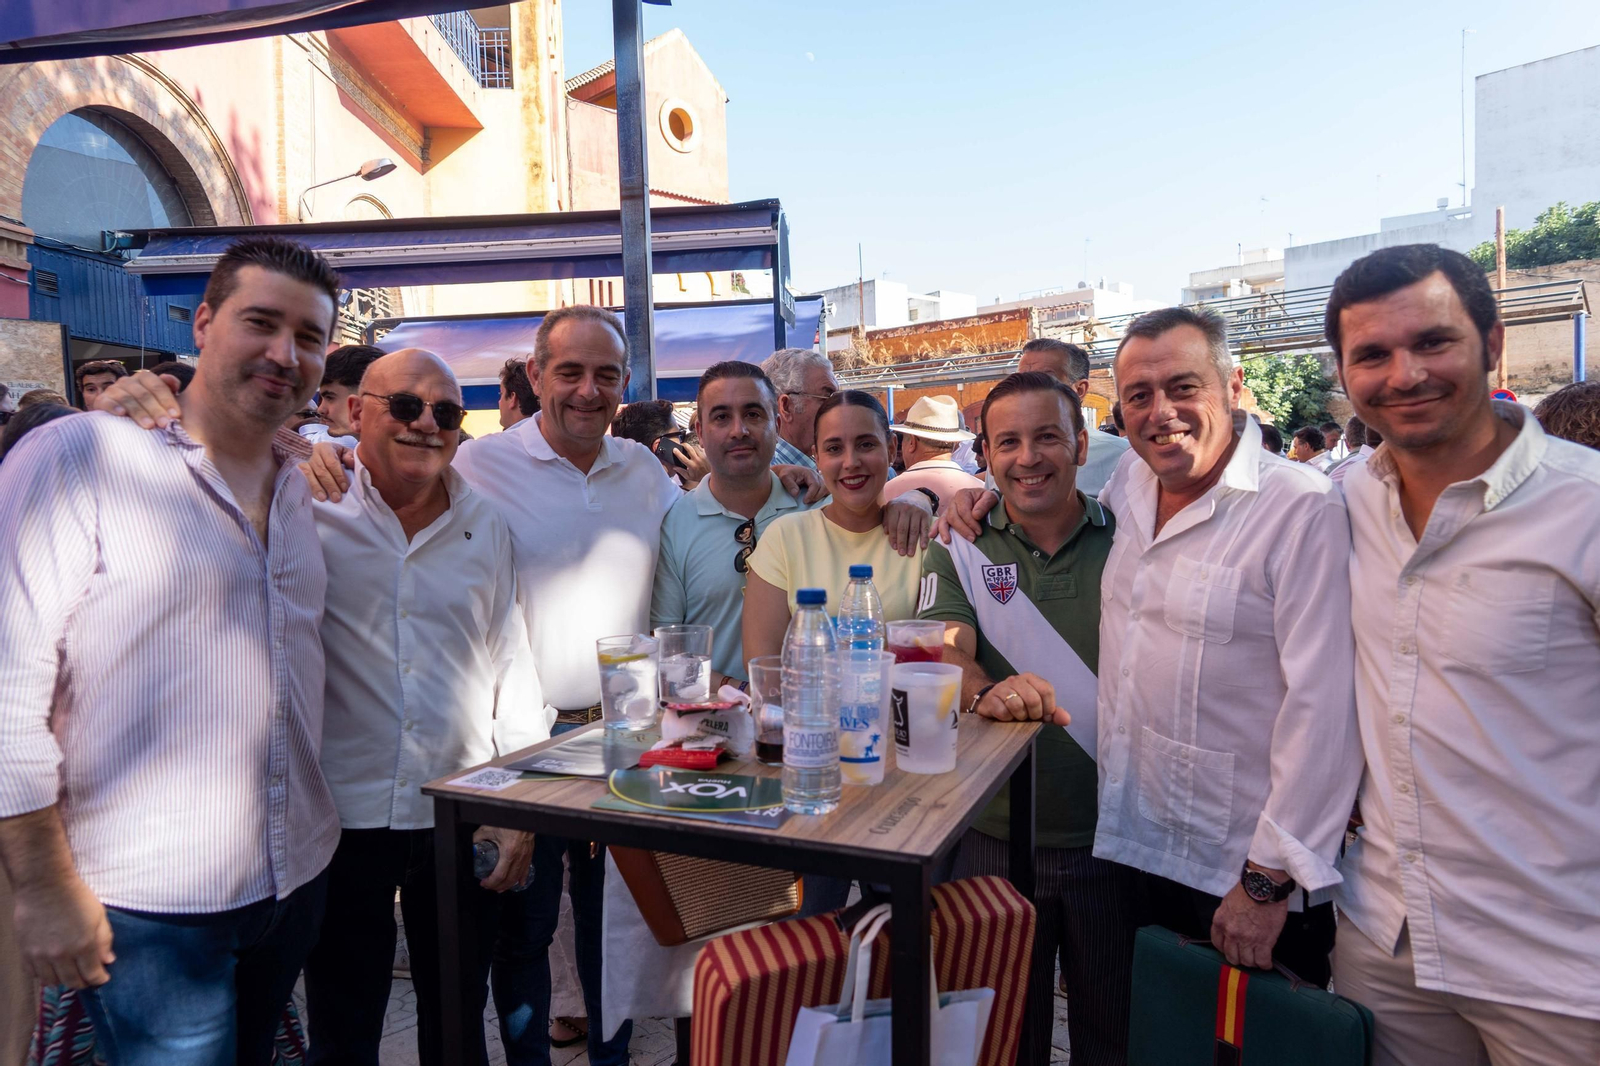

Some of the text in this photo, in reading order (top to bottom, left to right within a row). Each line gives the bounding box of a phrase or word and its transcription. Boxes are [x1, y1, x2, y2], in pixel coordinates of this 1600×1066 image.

[986, 566, 1012, 578] GBR
[697, 777, 732, 785] Huelva
[659, 781, 747, 799] VOX
